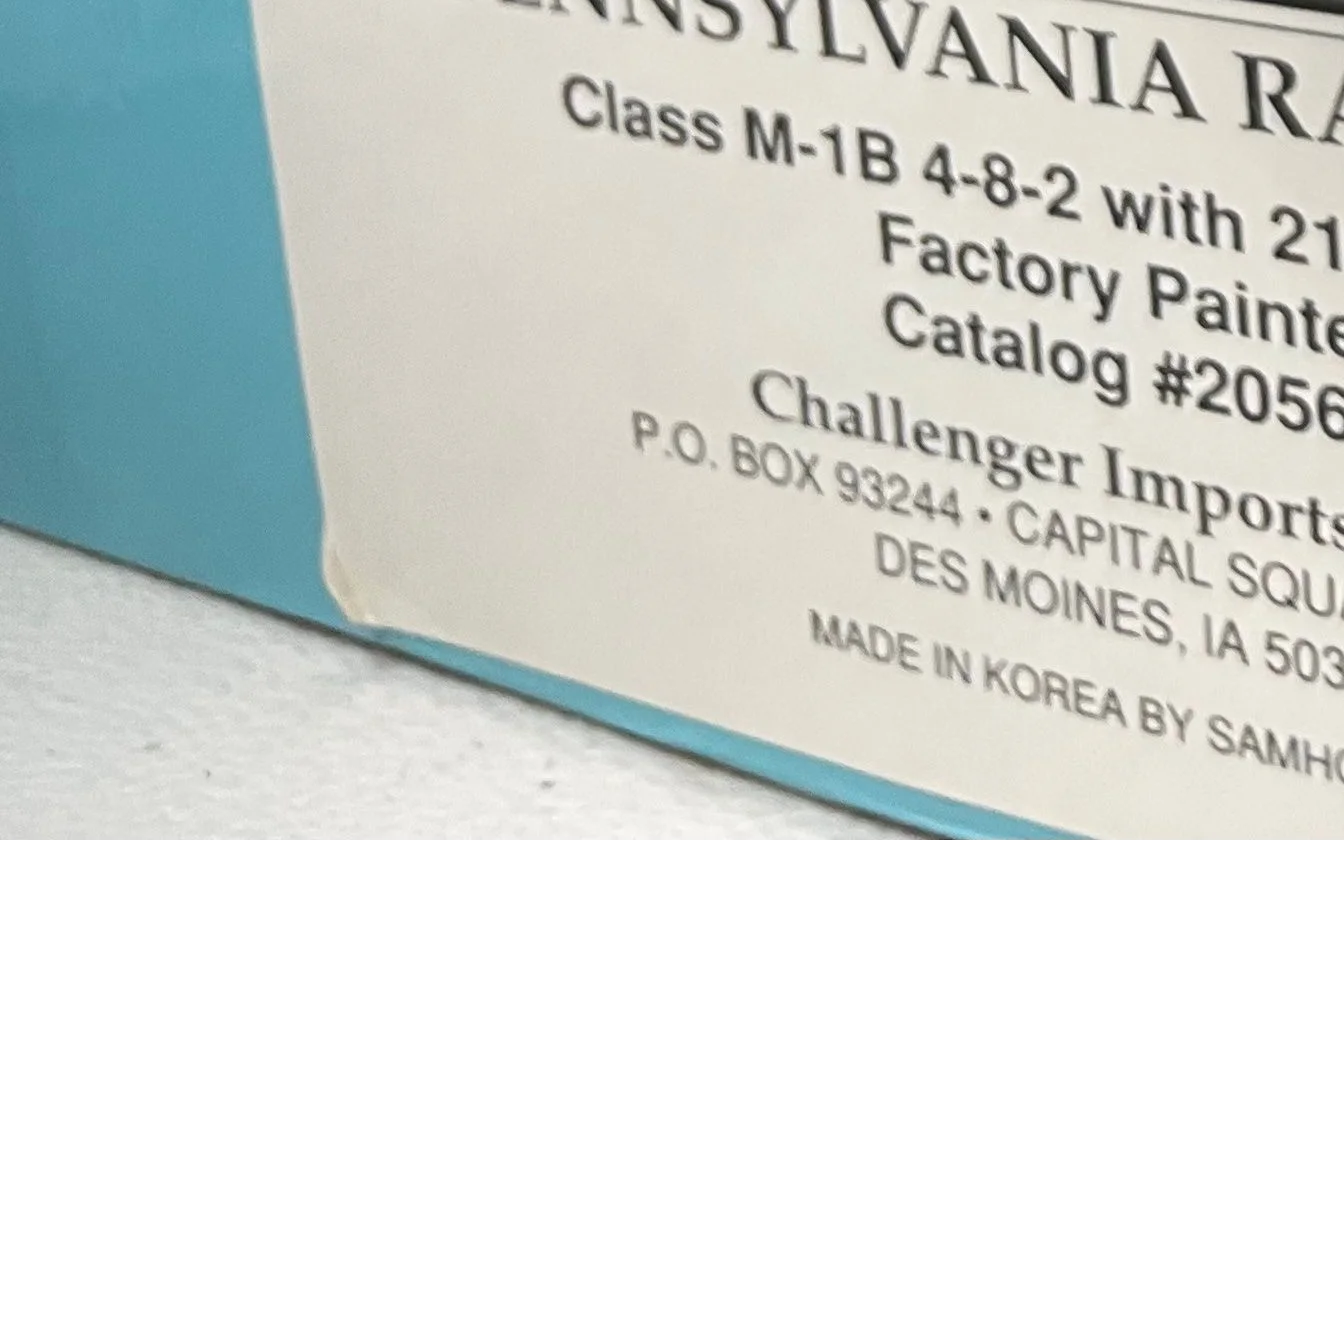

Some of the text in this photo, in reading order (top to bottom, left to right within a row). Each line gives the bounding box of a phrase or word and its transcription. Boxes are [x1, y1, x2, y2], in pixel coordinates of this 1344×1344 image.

[562, 75, 723, 153] Class
[744, 108, 899, 185] M-1B
[922, 144, 1081, 221] 4-8-2
[1101, 183, 1245, 253] with
[879, 212, 1120, 323] Factory
[883, 294, 1129, 408] Catalog
[751, 371, 1083, 491] Challenger
[633, 412, 718, 470] P.O.
[731, 434, 822, 494] BOX
[835, 462, 961, 526] 93244
[1007, 501, 1211, 588] CAPITAL
[876, 534, 968, 594] DES
[983, 560, 1190, 656] MOINES,
[1205, 615, 1249, 665] IA
[810, 610, 919, 671] MADE
[935, 646, 971, 684] IN
[985, 659, 1126, 726] KOREA
[1140, 696, 1192, 742] BY
